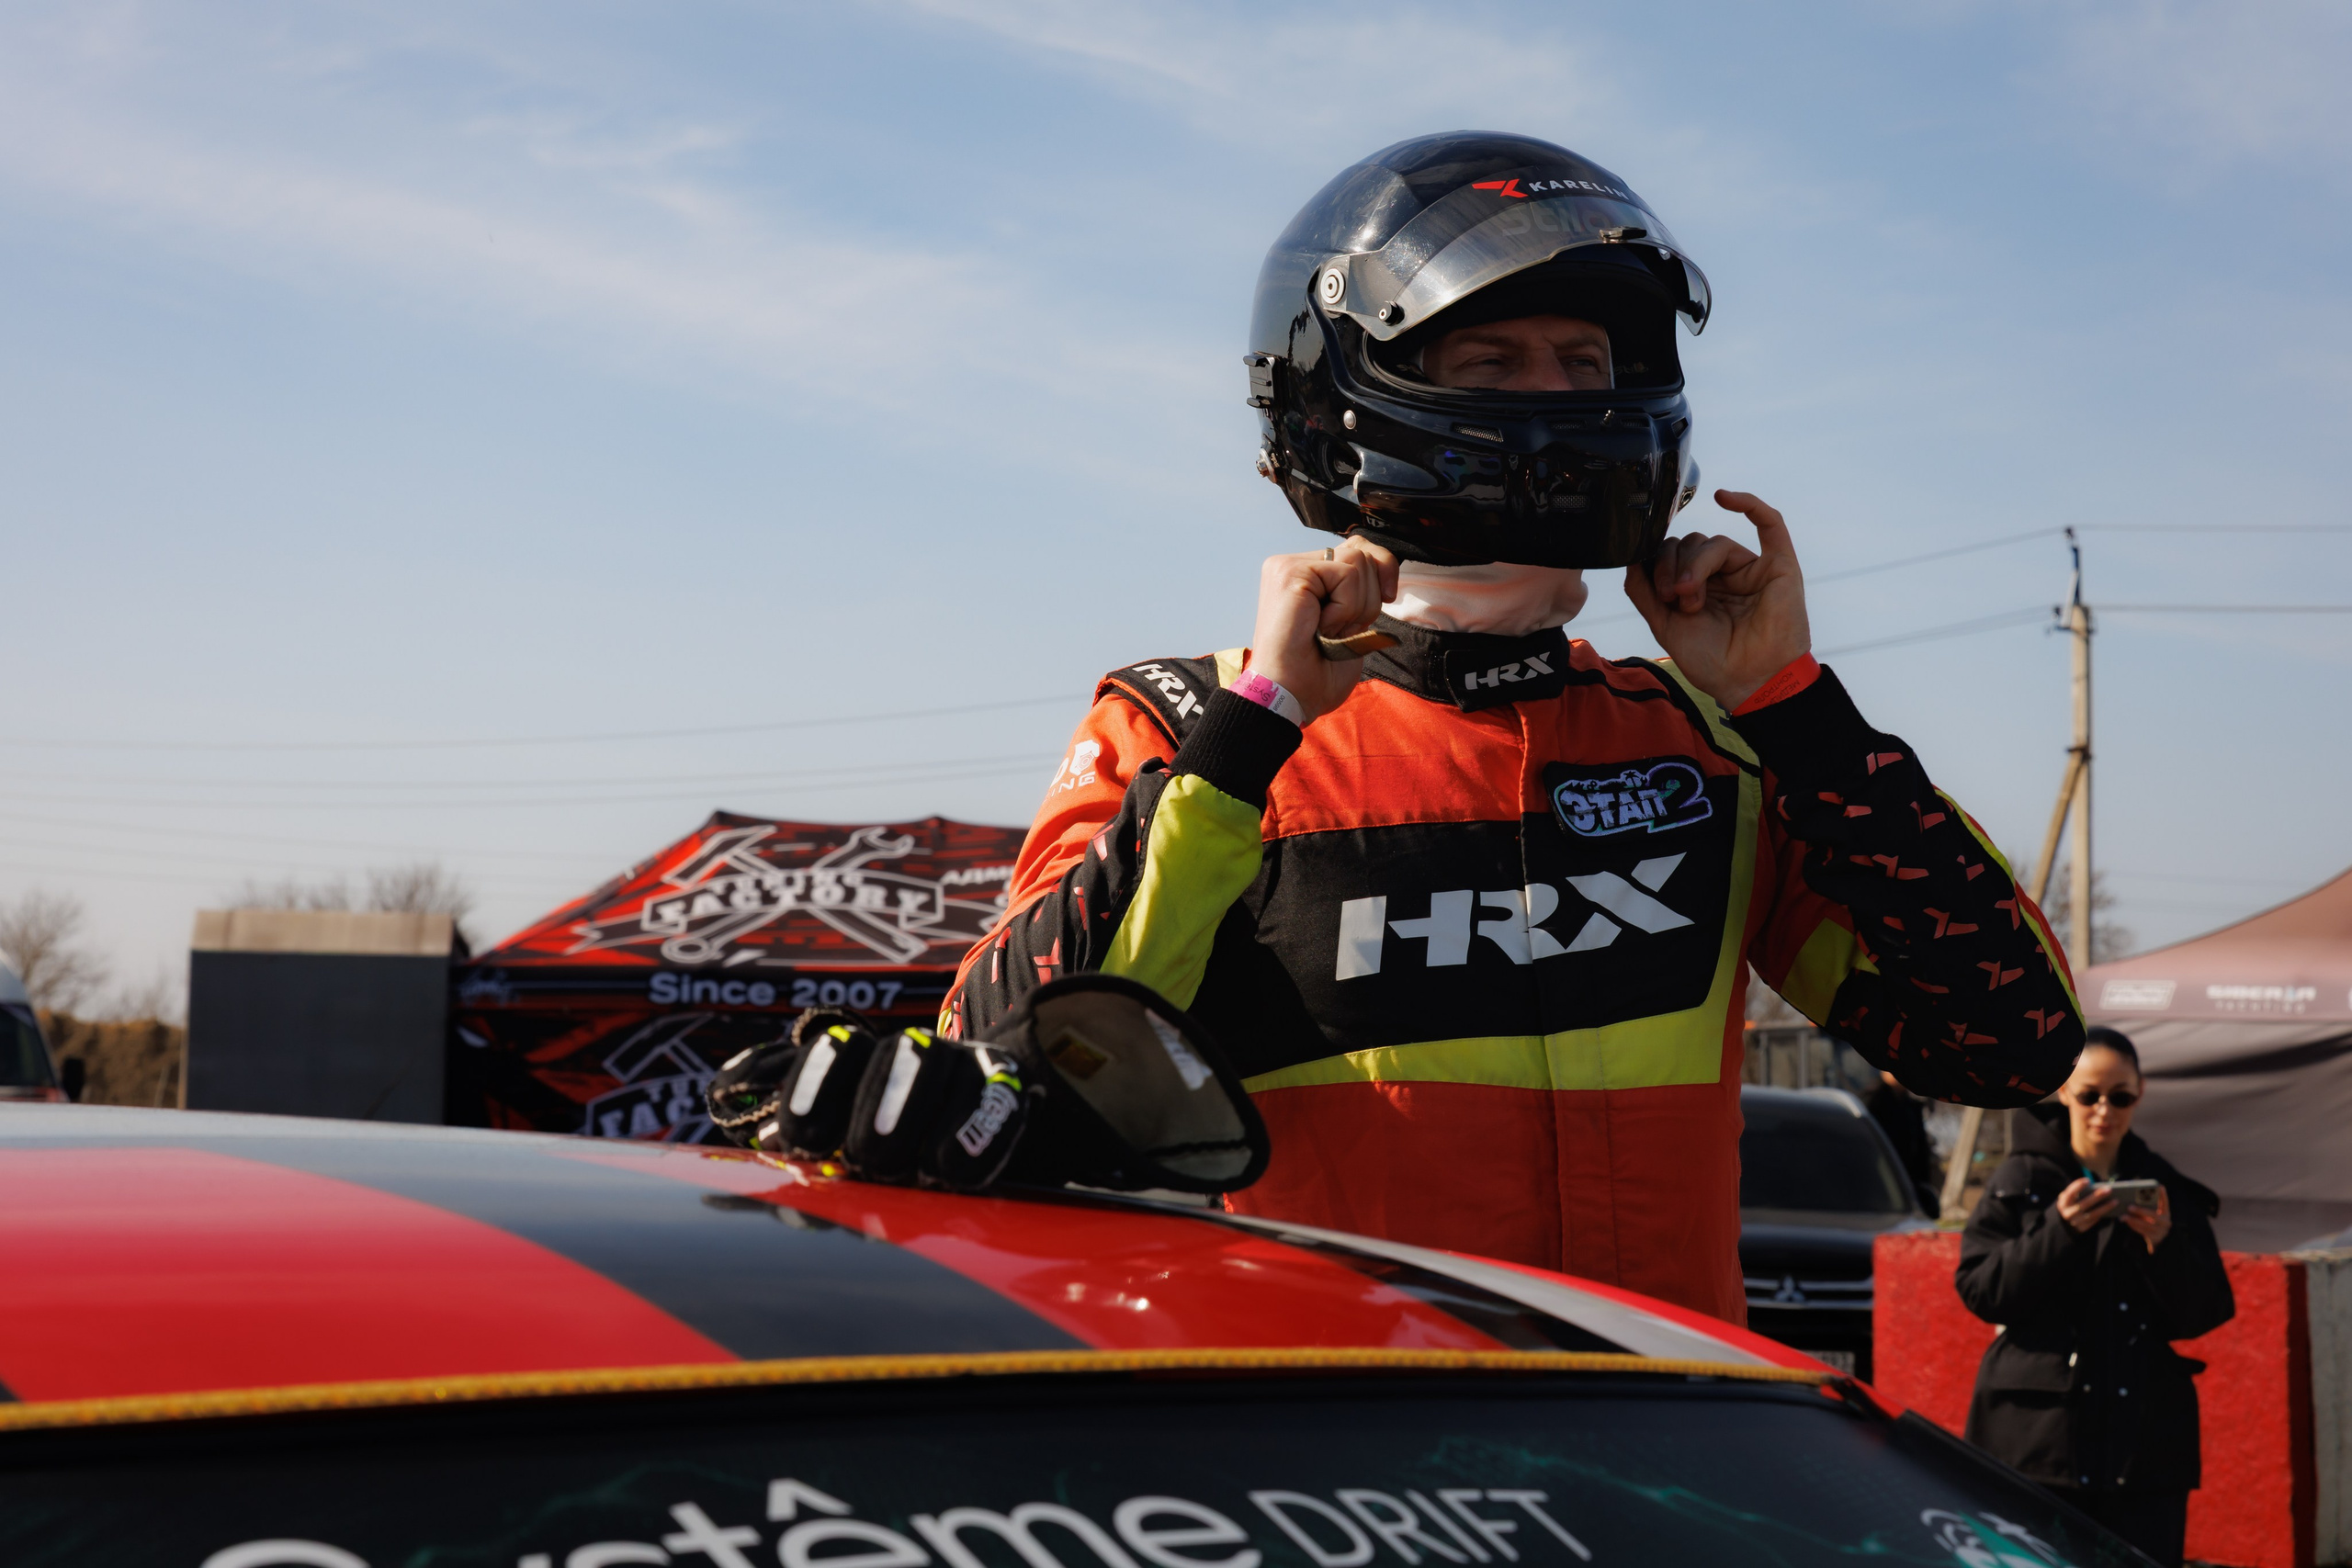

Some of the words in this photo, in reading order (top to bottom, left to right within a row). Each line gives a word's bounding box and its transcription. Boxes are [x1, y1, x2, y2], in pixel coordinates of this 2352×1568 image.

[1528, 179, 1630, 201] KARELIN
[1464, 650, 1555, 691] HRX
[1753, 671, 1794, 705] КОНТРОЛЬ
[1050, 771, 1096, 797] ING
[655, 883, 932, 922] FACTORY
[1335, 851, 1696, 982] HRX
[648, 971, 777, 1006] Since
[789, 977, 903, 1010] 2007
[1250, 1488, 1593, 1566] DRIFT
